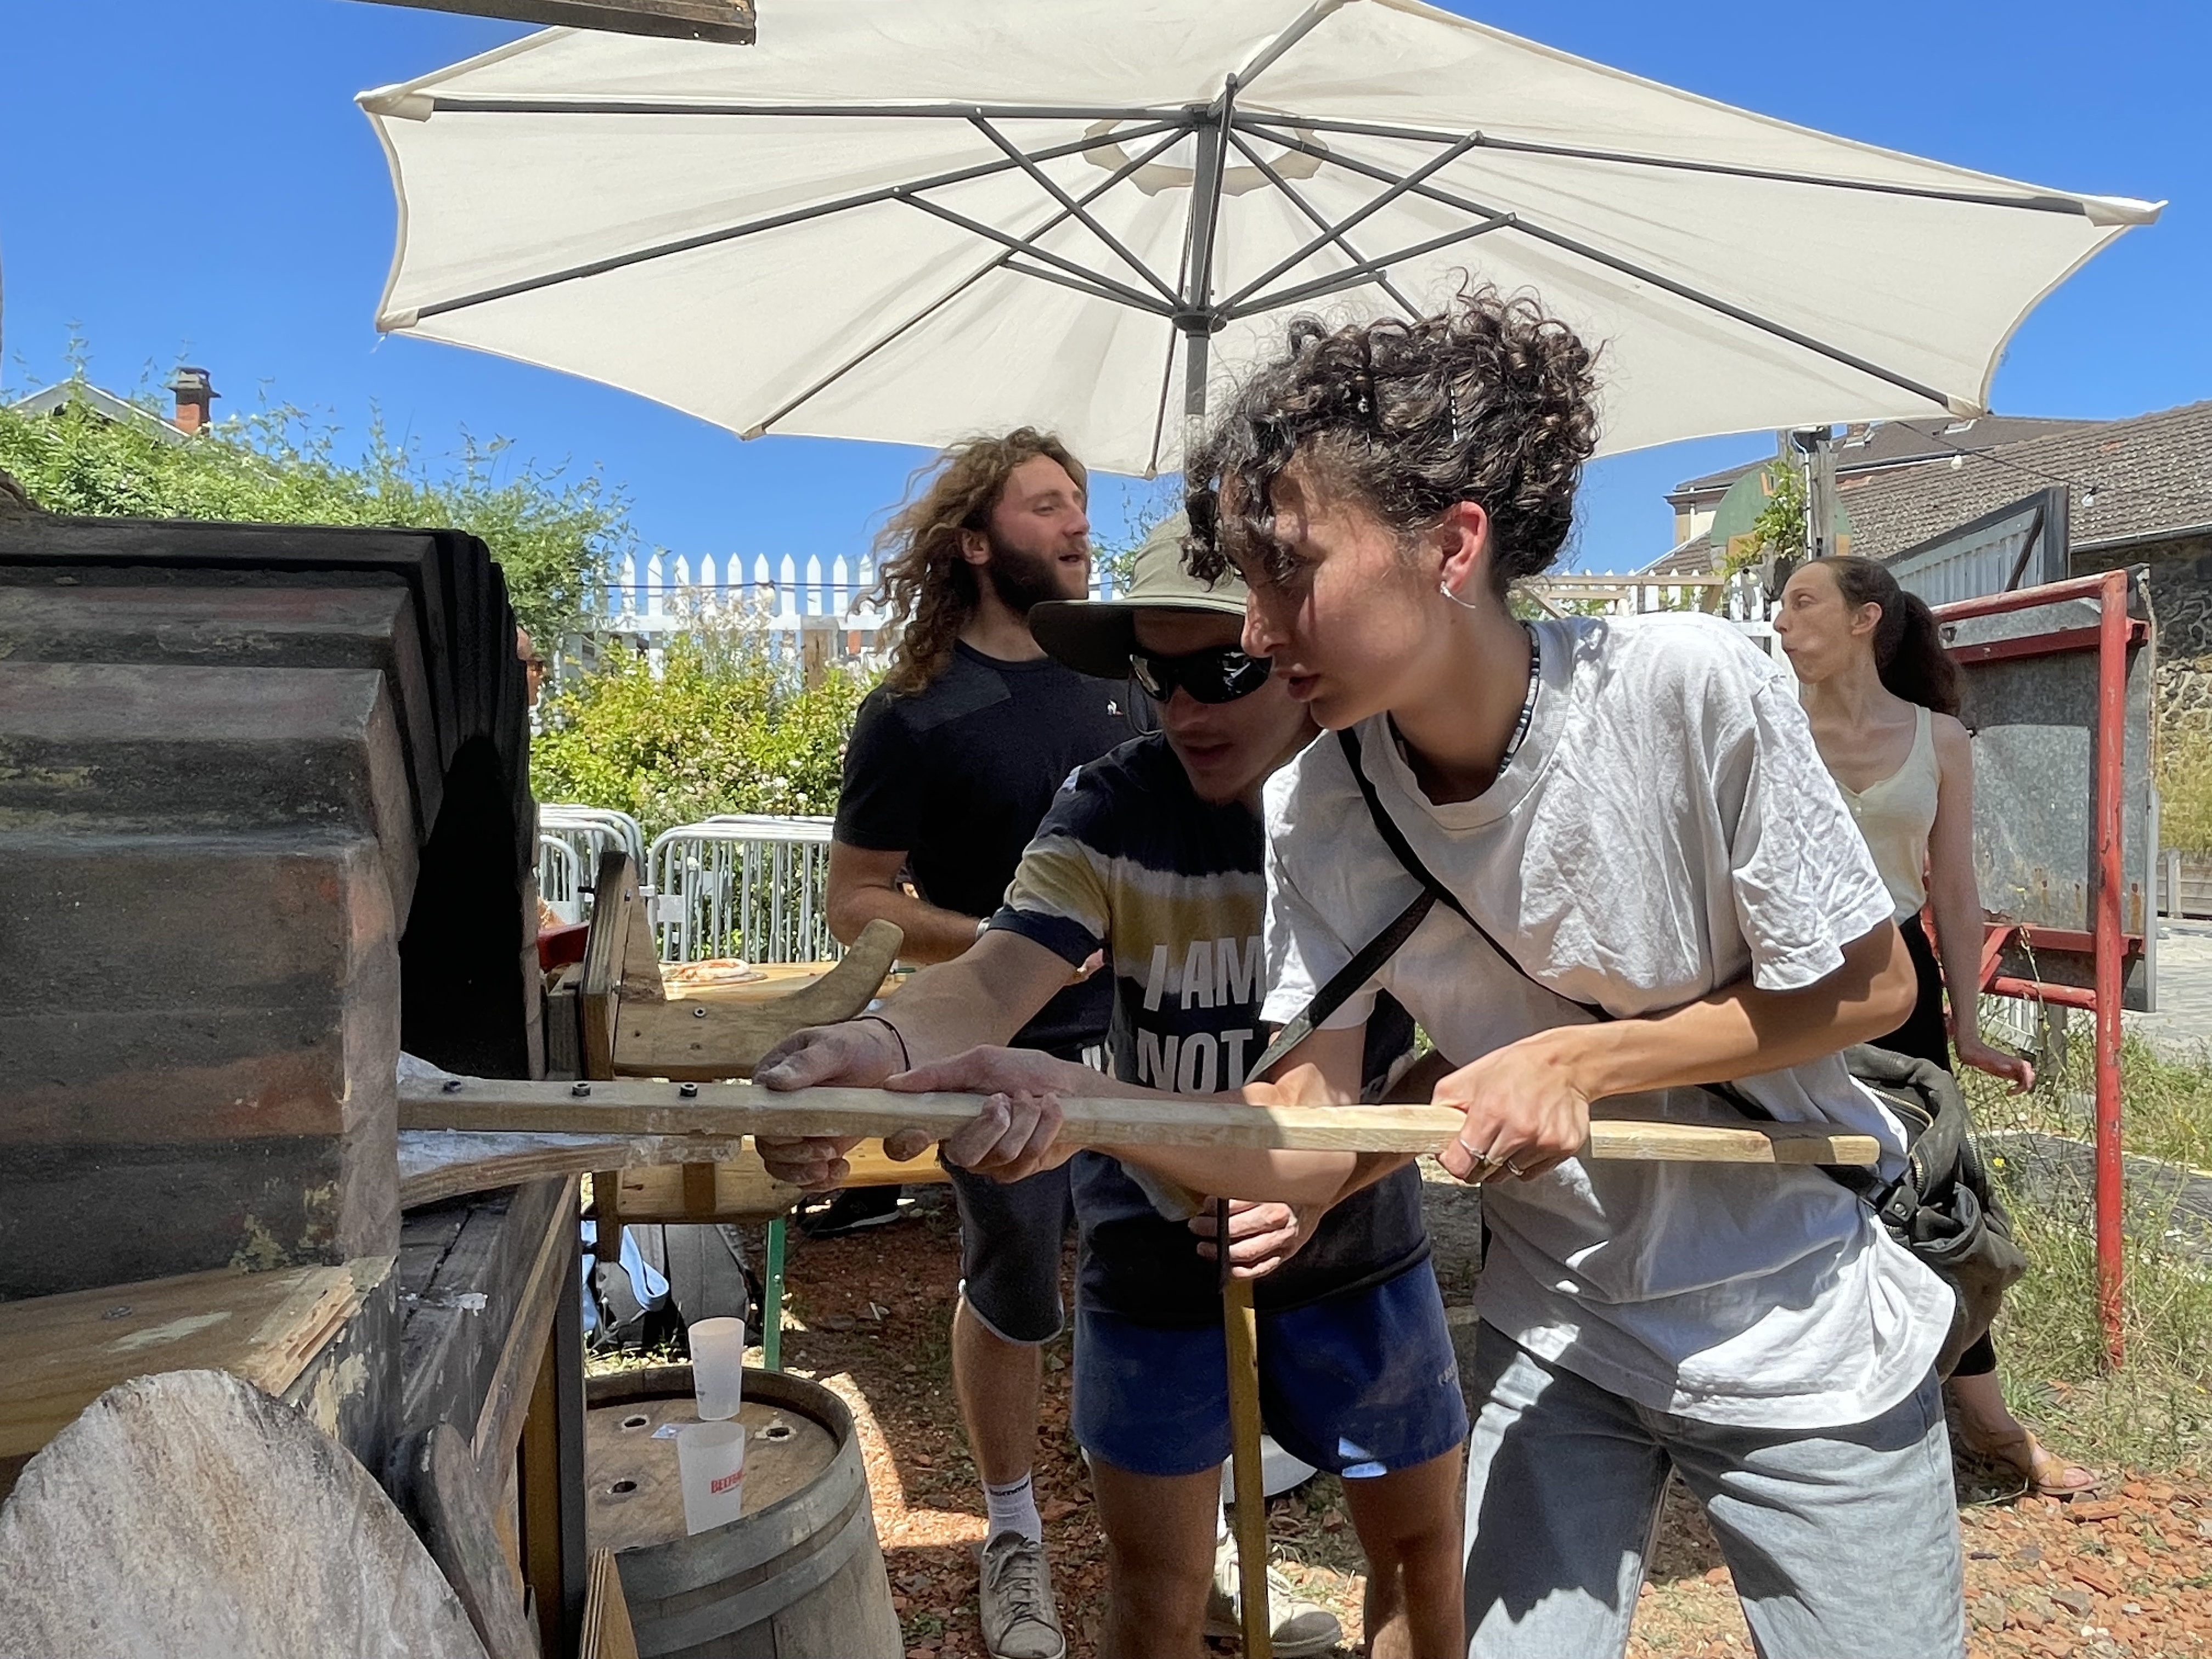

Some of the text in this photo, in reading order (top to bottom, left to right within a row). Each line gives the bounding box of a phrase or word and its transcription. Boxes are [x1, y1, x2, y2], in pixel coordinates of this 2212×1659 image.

[1143, 935, 1265, 1012] I AM
[1137, 1027, 1254, 1094] NOT
